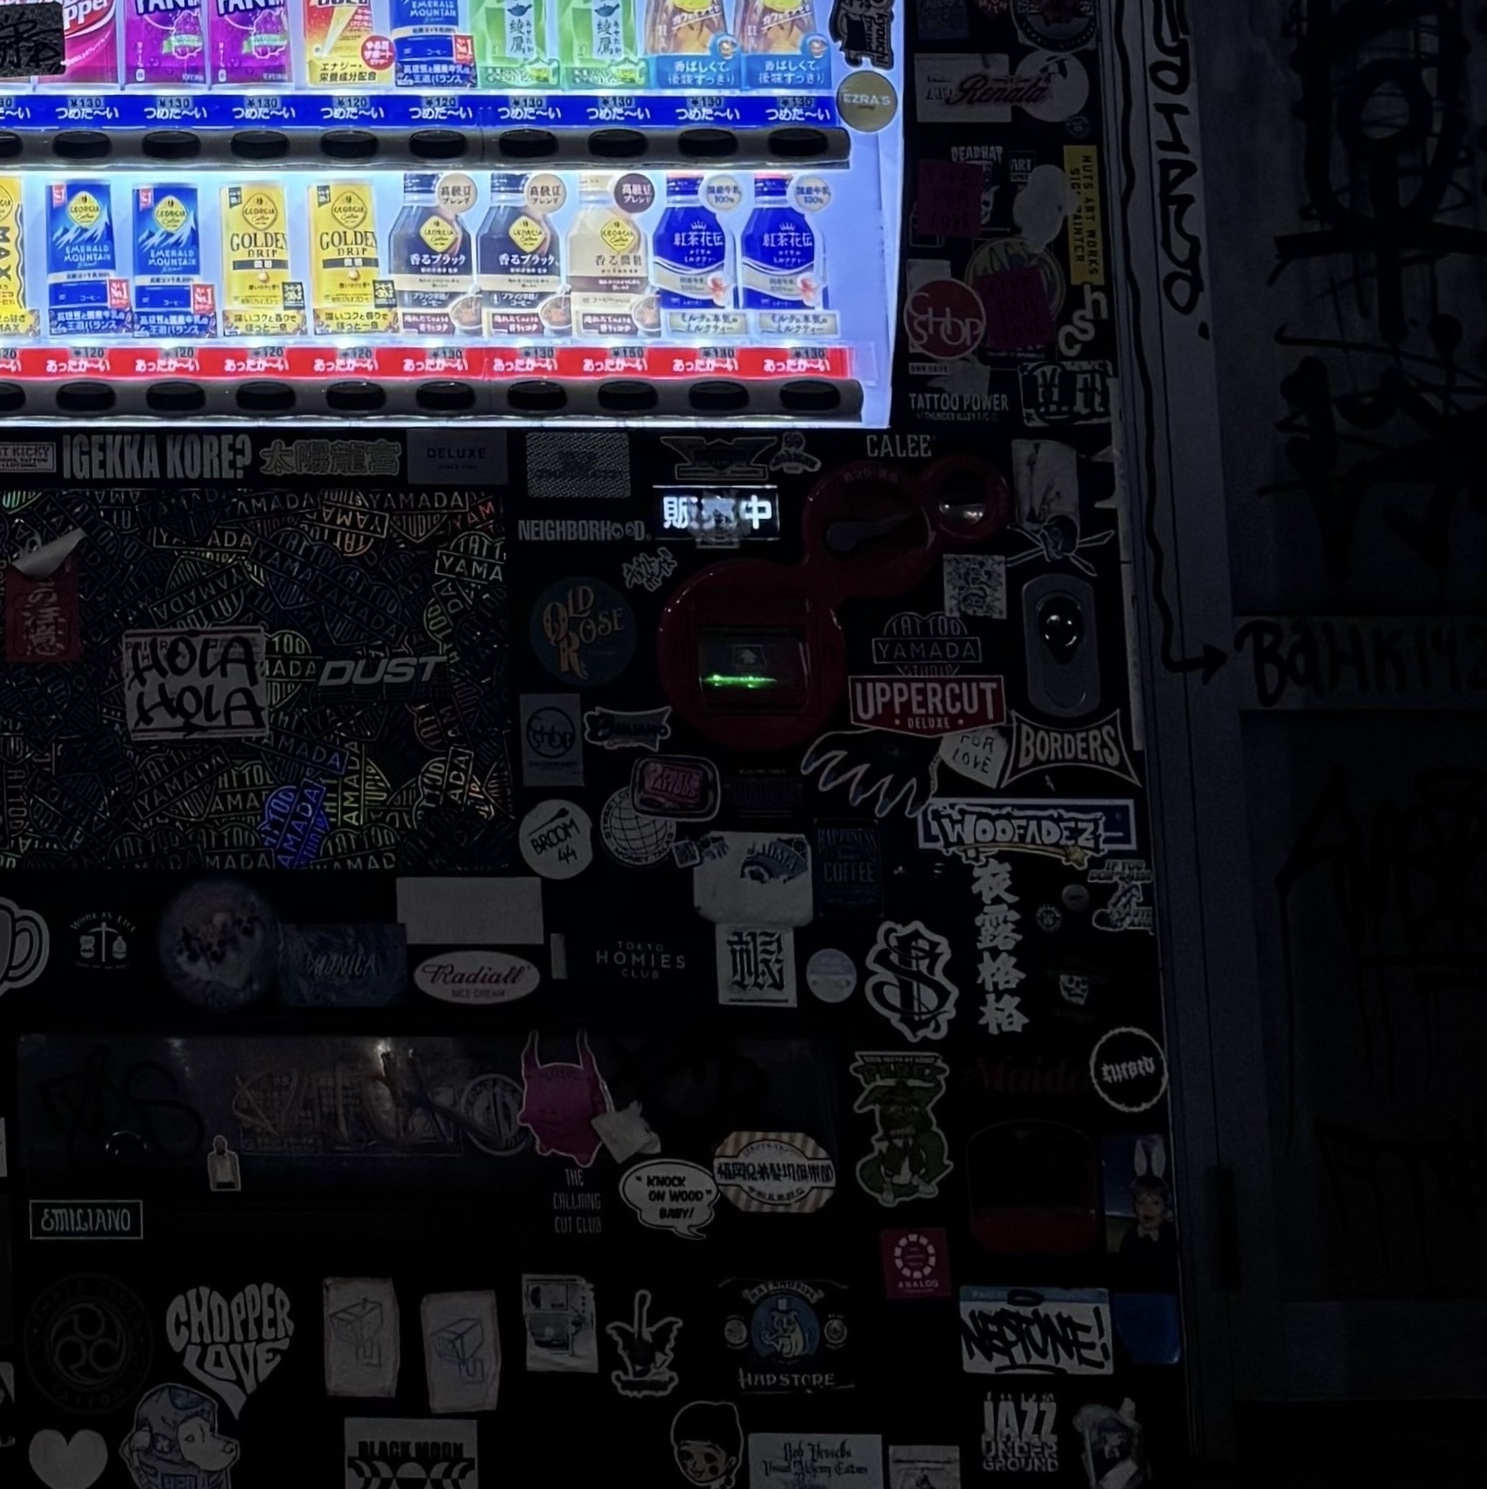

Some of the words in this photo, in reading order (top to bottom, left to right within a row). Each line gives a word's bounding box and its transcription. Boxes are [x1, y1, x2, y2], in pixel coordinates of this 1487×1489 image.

[951, 145, 1003, 163] DEADHAT
[1086, 196, 1096, 224] ART
[64, 253, 111, 262] MOUNTAIN
[65, 246, 109, 254] EMERALD
[150, 249, 195, 258] EMERALD
[1087, 233, 1099, 276] WORKS
[148, 258, 196, 267] MOUNTAIN
[908, 393, 961, 411] TATTOO
[963, 392, 1010, 411] POWER
[61, 434, 160, 479] IGEKKA
[166, 433, 253, 479] KORE?
[427, 447, 486, 460] DELUXE
[866, 433, 933, 458] CALEE
[887, 613, 962, 636] TATTOO
[319, 656, 448, 686] DUST
[134, 684, 264, 727] HOLA
[855, 682, 999, 719] UPPERCUT
[907, 717, 951, 729] DELUXE
[1018, 725, 1121, 769] BORDERS
[531, 818, 581, 855] BROOM
[558, 843, 578, 864] 44
[616, 940, 663, 952] TOKYO
[595, 949, 686, 970] HOMIES
[621, 967, 659, 980] CLUB
[646, 1176, 686, 1187] KNOCK
[648, 1190, 665, 1201] ON
[898, 1279, 939, 1289] ANALOG
[165, 1282, 295, 1352] CHOPPER
[181, 1339, 290, 1421] LOVE
[981, 1399, 1058, 1442] JAZZ
[358, 1441, 411, 1459] BLACK
[415, 1441, 464, 1459] MOON
[981, 1438, 1060, 1459] UNDER
[982, 1457, 1060, 1473] GROUND
